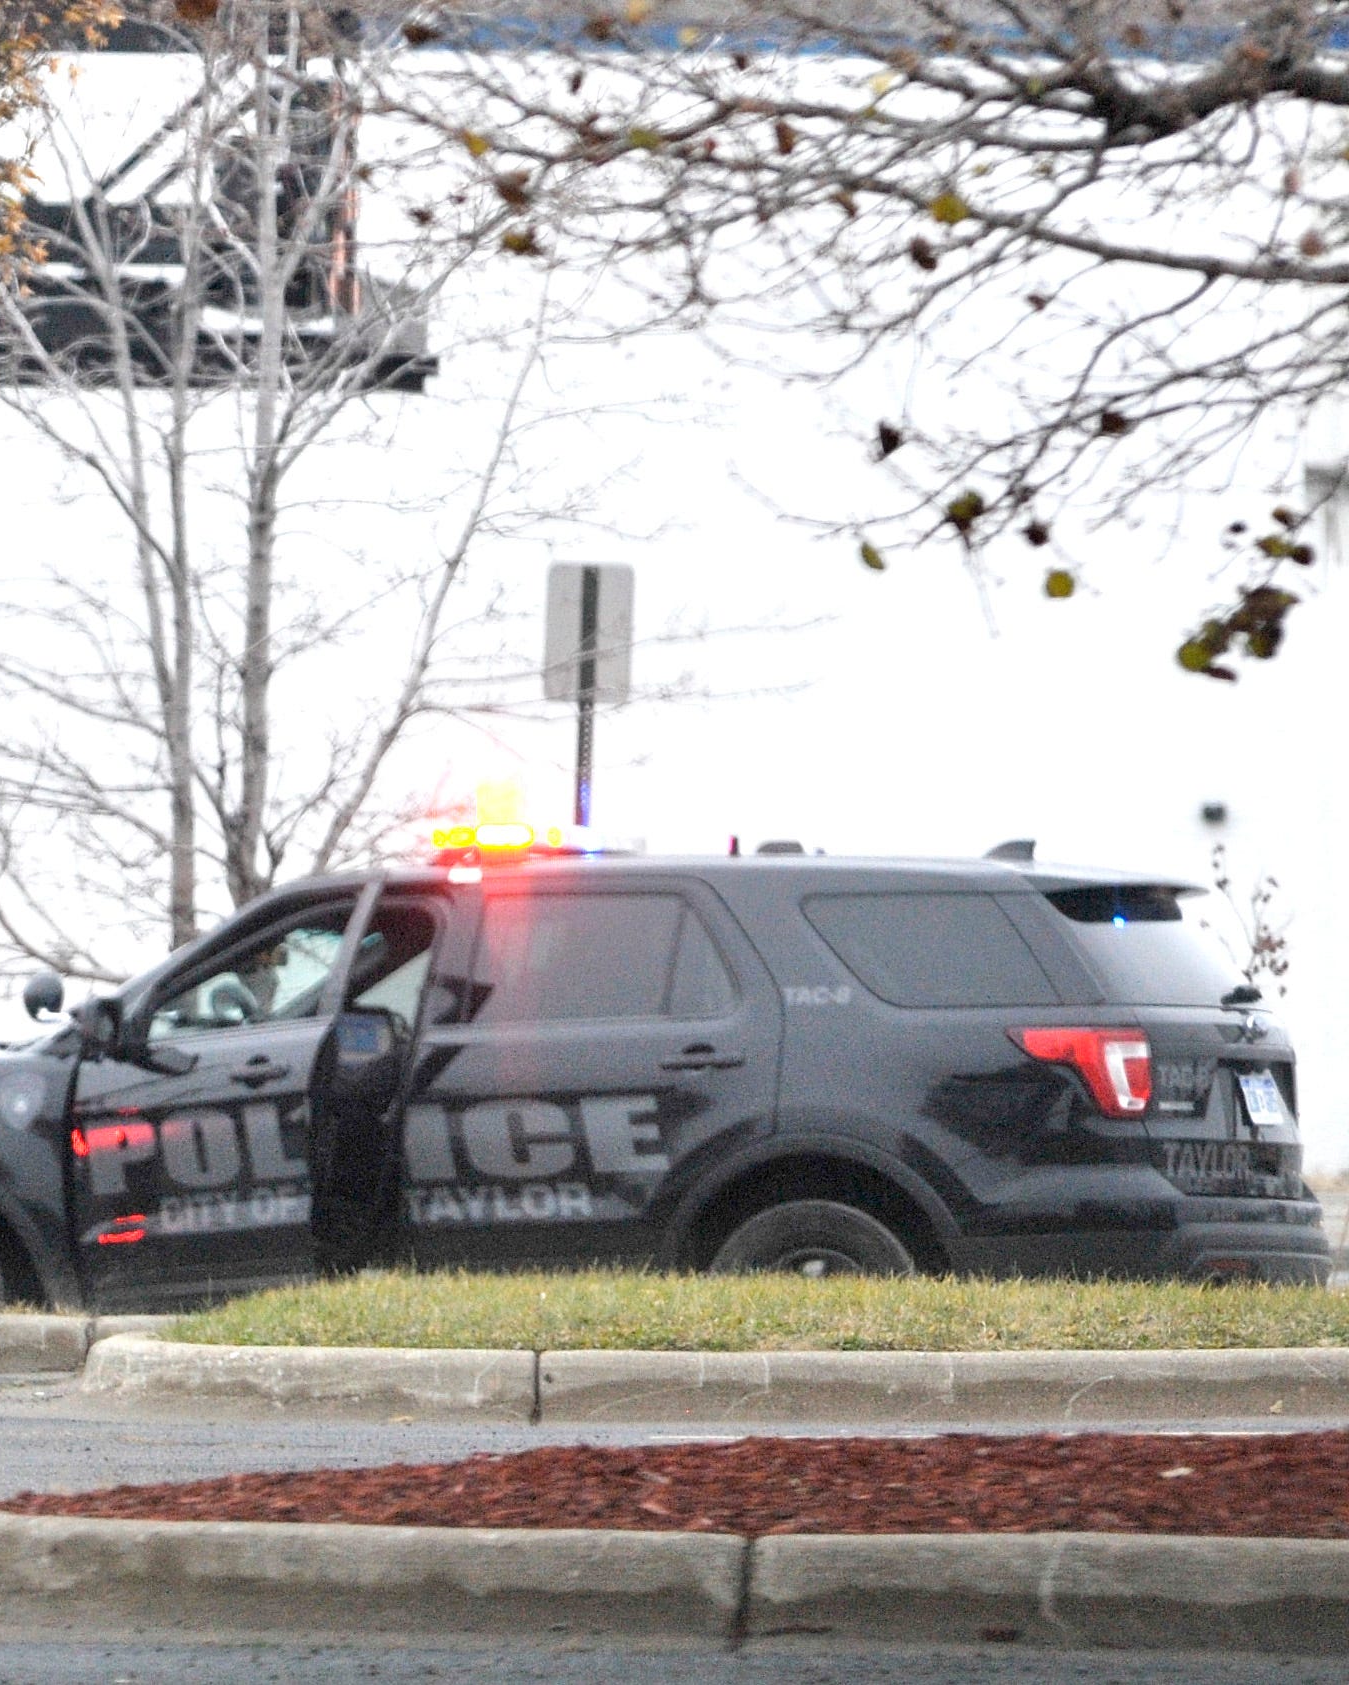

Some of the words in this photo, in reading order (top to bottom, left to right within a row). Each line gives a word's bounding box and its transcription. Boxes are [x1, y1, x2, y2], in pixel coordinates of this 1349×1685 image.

[86, 1095, 669, 1195] POLICE
[1163, 1142, 1252, 1179] TAYLOR
[161, 1191, 239, 1232] CITY
[251, 1185, 297, 1225] OF
[403, 1182, 592, 1222] TAYLOR
